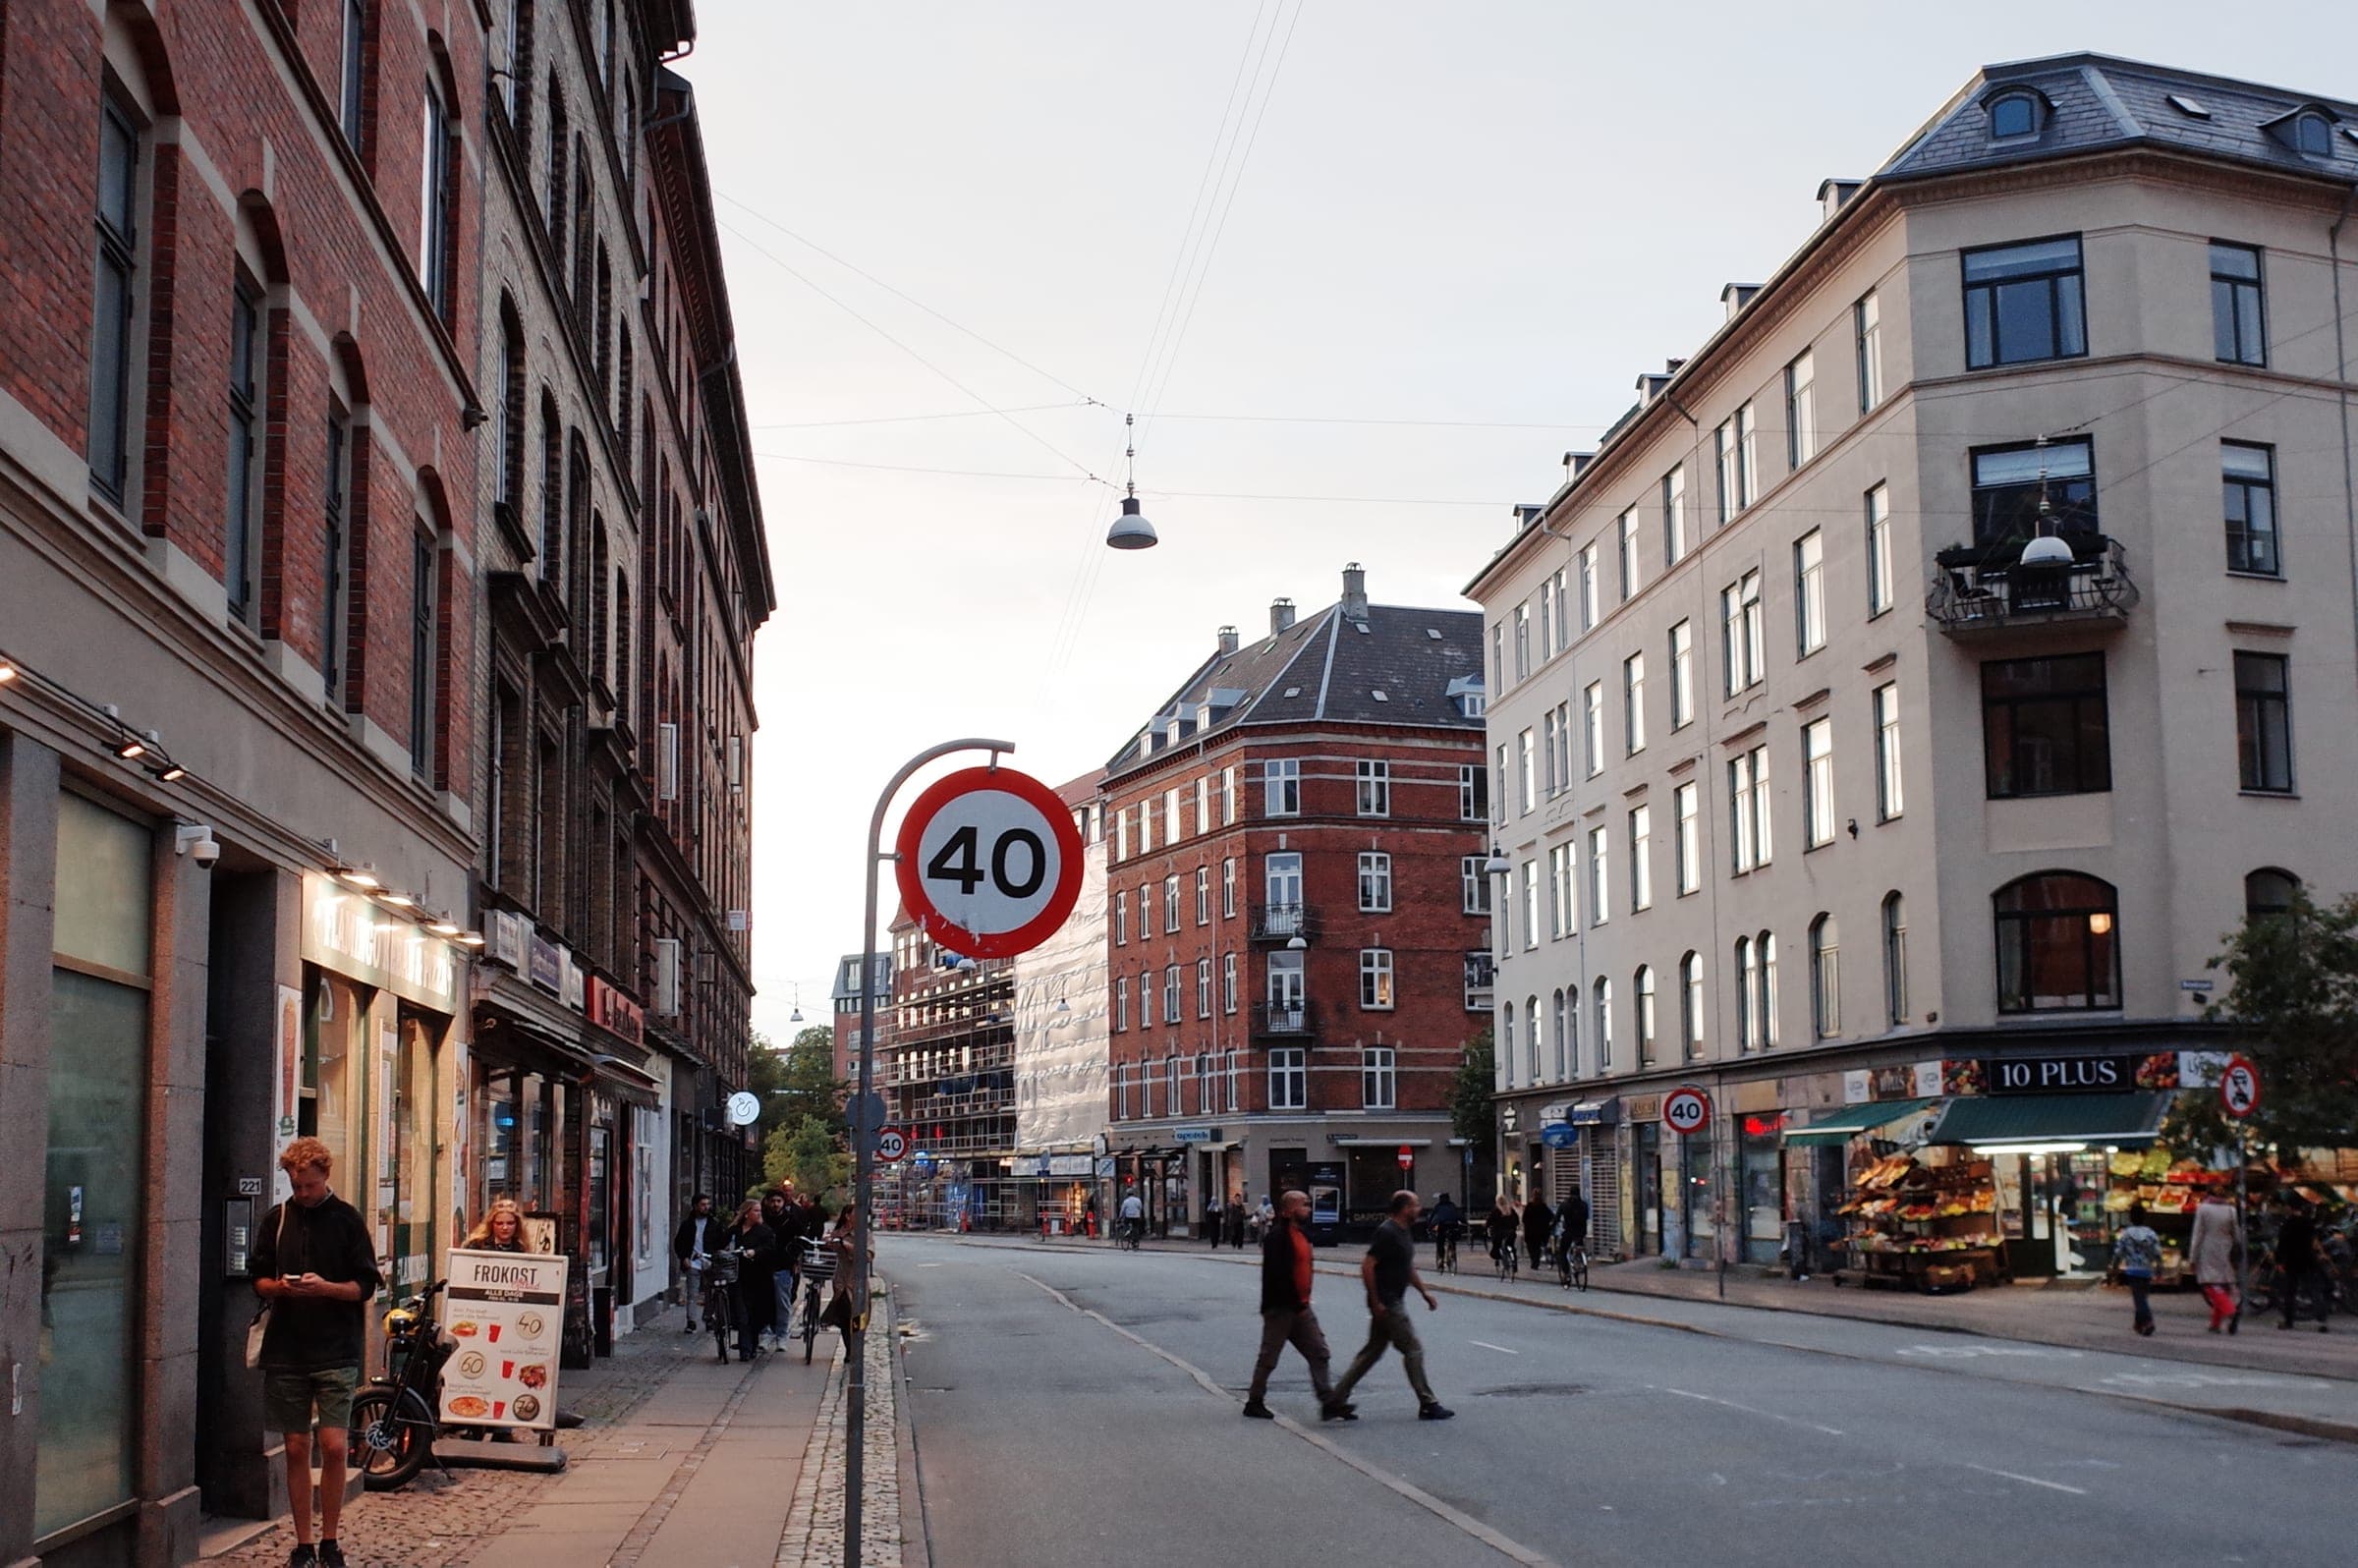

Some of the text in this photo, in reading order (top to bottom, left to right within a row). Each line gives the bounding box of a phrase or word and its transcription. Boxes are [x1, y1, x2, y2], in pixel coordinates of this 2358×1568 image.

[927, 825, 1046, 899] 40
[2001, 1060, 2117, 1088] 10 PLUS
[1671, 1101, 1701, 1121] 40
[880, 1138, 902, 1151] 40
[242, 1181, 259, 1192] 221
[475, 1264, 537, 1285] FROKOST
[518, 1315, 541, 1334] 40
[461, 1357, 484, 1373] 60
